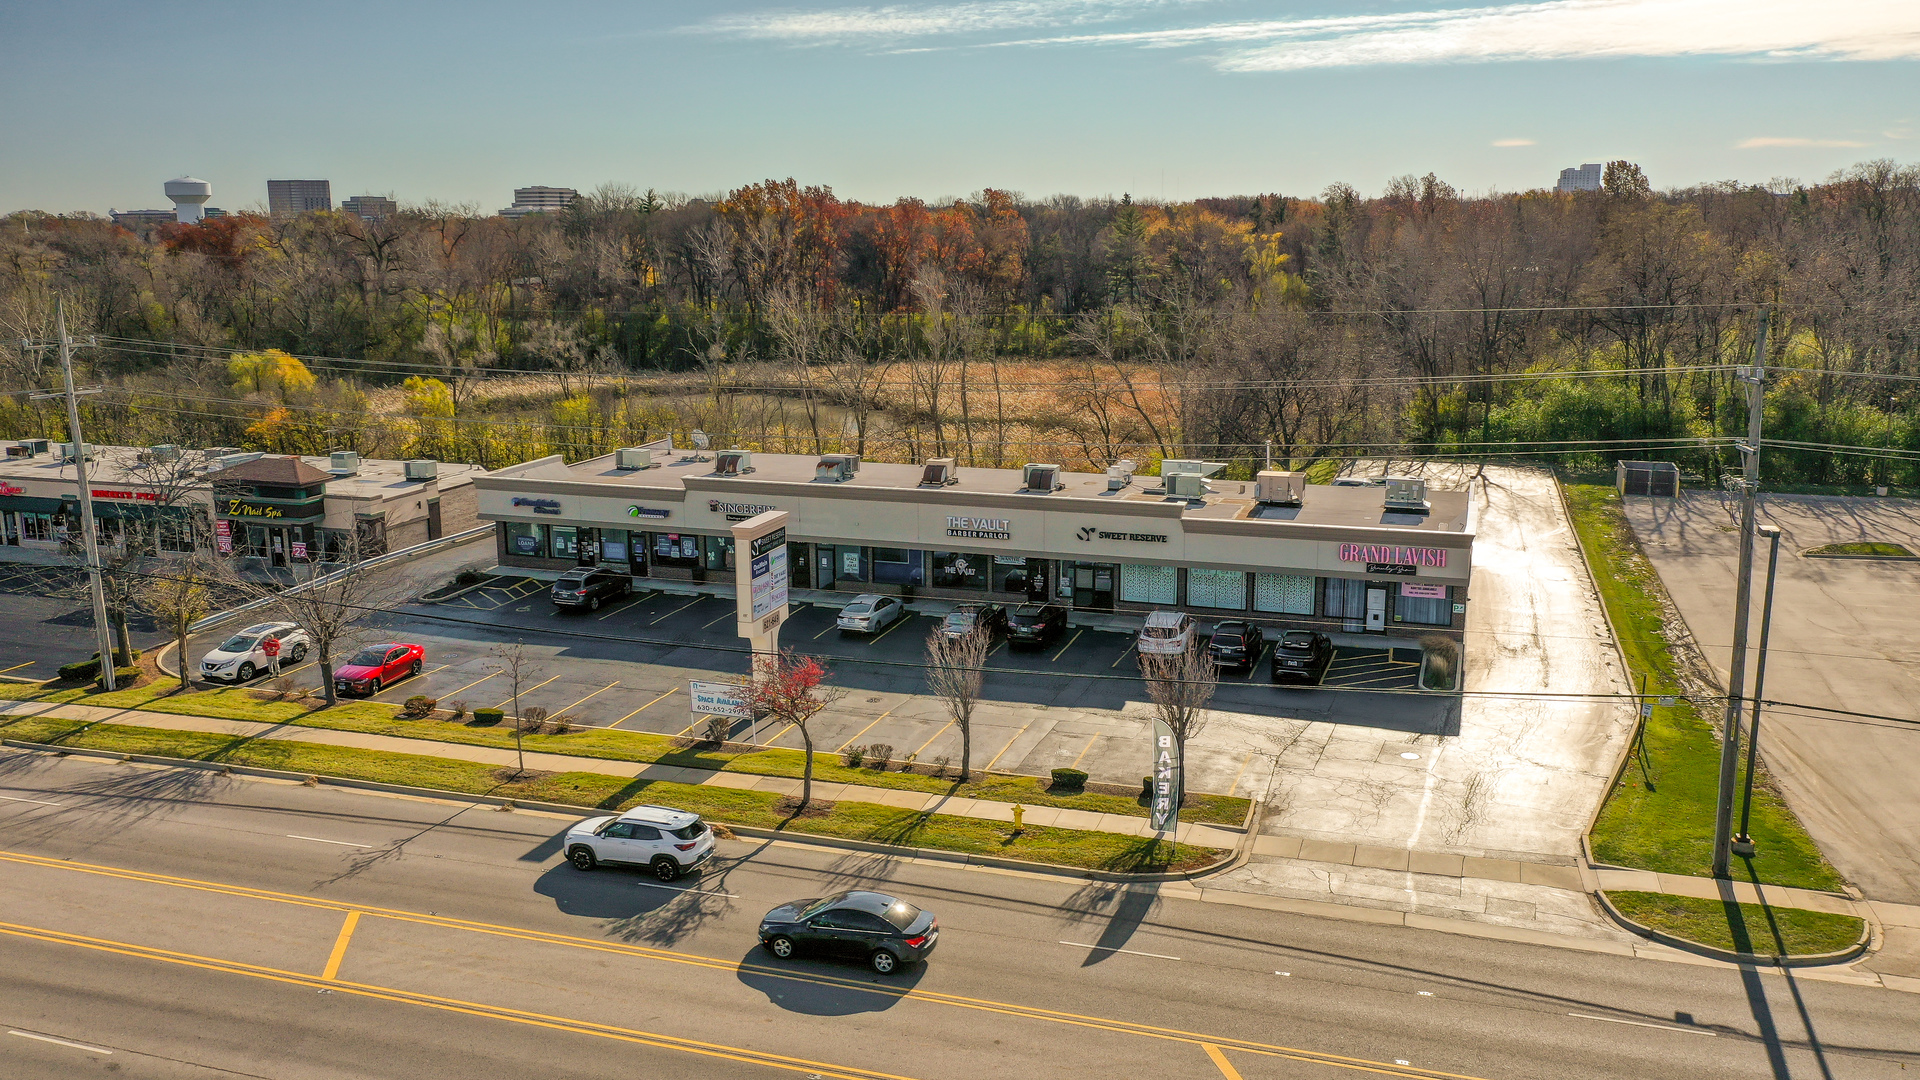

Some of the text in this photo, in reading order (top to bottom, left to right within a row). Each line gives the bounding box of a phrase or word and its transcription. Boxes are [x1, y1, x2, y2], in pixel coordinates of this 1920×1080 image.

[228, 498, 282, 519] Z Nail Spa
[946, 516, 1010, 531] THE VAULT
[947, 529, 1009, 540] BARBER PARLOR
[1098, 531, 1168, 543] SWEET RESERVE
[1340, 543, 1447, 567] GRAND LAVISH
[697, 694, 714, 704] SPACE
